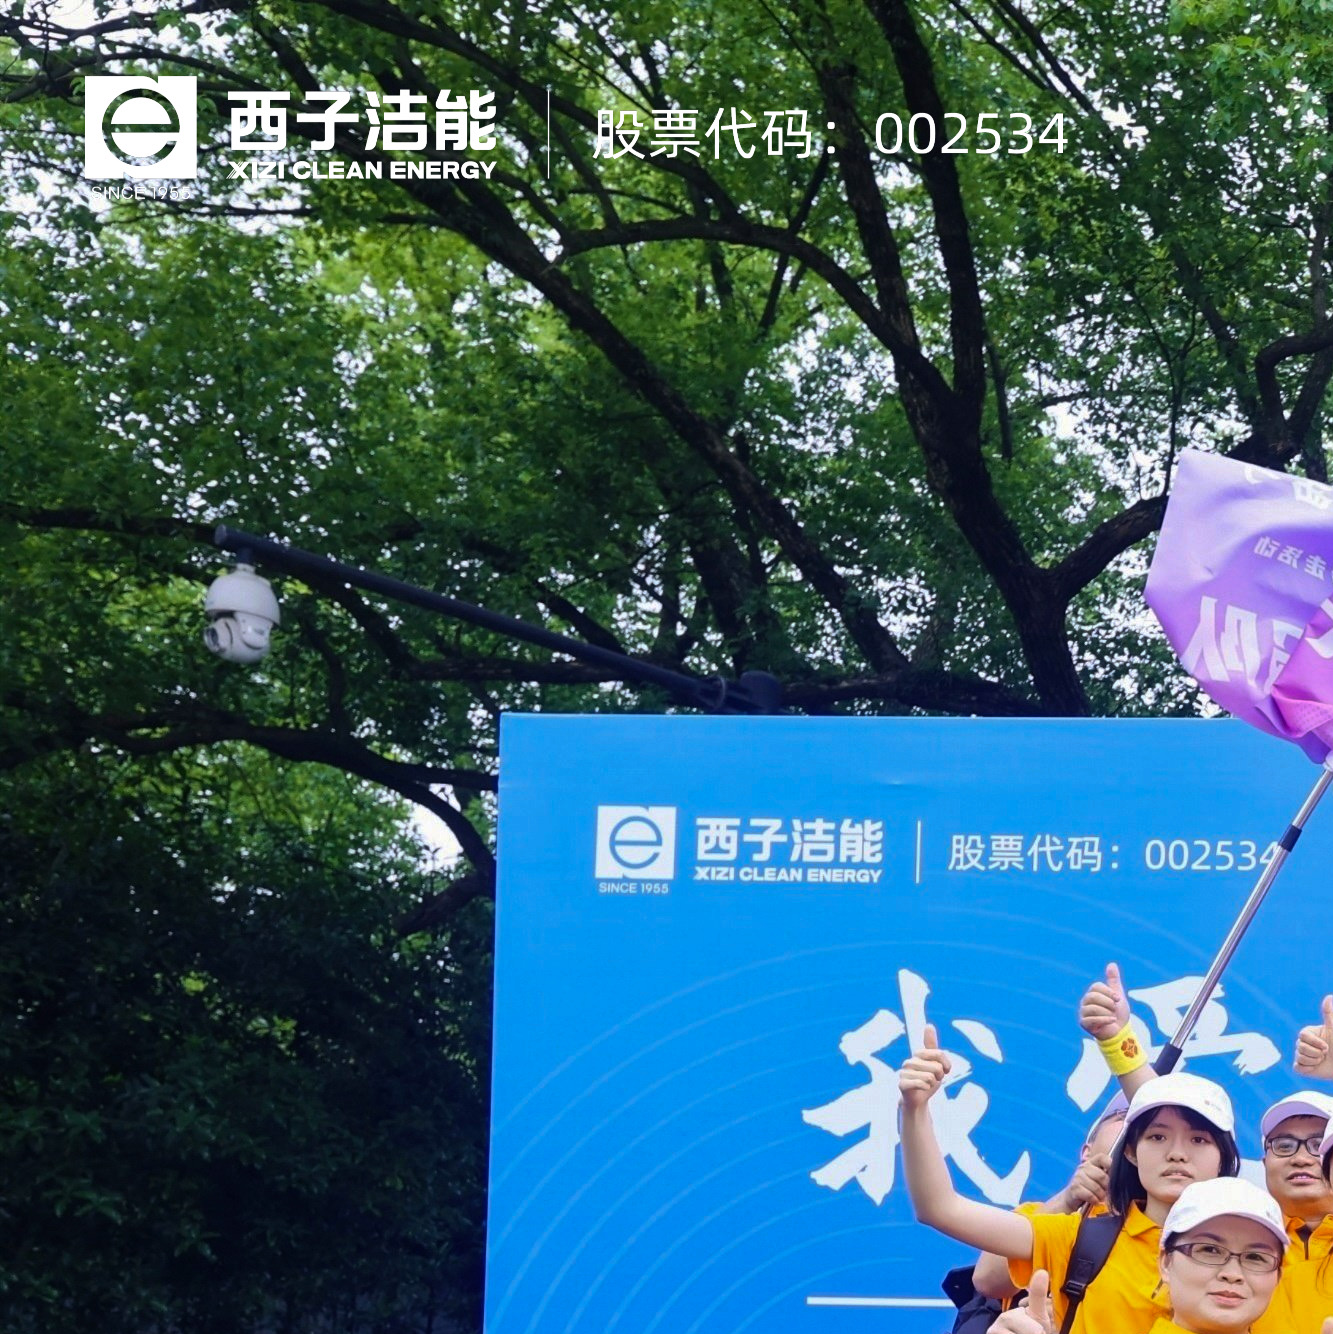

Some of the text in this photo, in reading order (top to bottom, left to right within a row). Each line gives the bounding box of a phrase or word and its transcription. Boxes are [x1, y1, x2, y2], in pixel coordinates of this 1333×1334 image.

[696, 816, 883, 864] 西子洁能
[693, 866, 883, 884] XIZI CLEAN ENERGY
[599, 882, 669, 895] SINCE 1955
